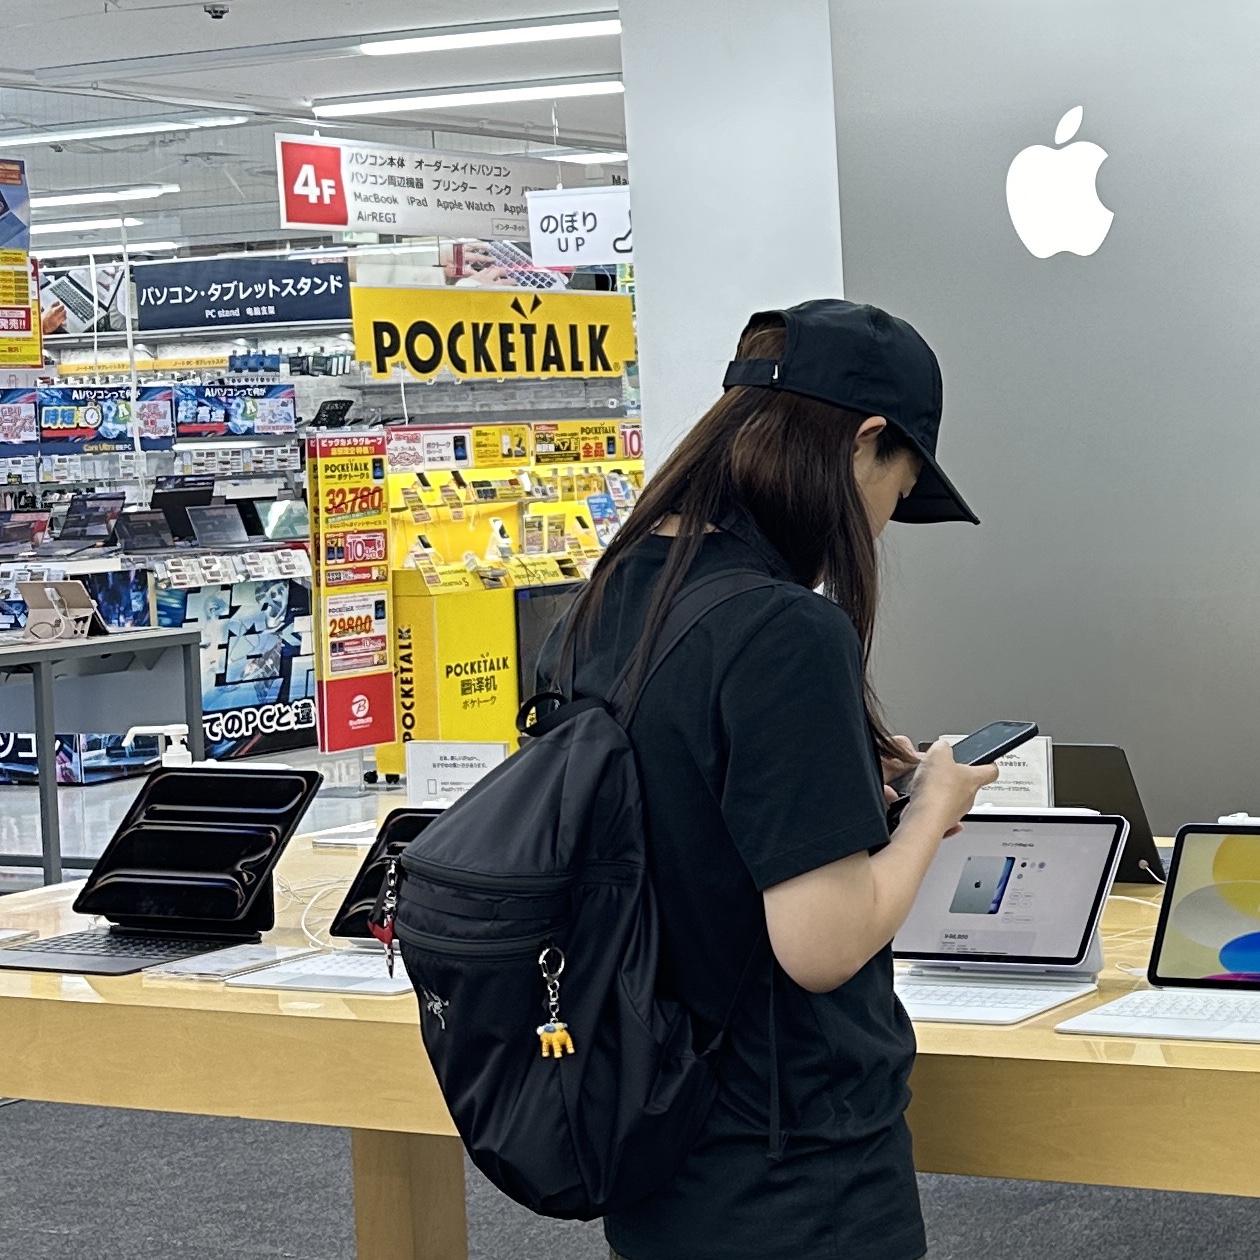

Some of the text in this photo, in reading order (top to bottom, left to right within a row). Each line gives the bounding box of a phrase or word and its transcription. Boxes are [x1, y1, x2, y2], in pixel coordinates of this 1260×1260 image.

[349, 152, 511, 178] パソコン本体 オーダーメイドパソコン
[293, 163, 337, 205] 4F
[432, 178, 478, 194] プリンター
[486, 183, 512, 196] インク
[353, 192, 399, 205] MacBook
[406, 196, 428, 208] iPad
[436, 198, 463, 211] Apple
[464, 200, 496, 213] Watch
[356, 210, 397, 224] AirREGI
[540, 211, 598, 235] のぼり
[140, 274, 344, 306] パソコン・タブレットスタンド
[372, 320, 613, 375] POCKETALK
[445, 656, 510, 679] POCKETALK
[462, 695, 497, 710] ポケトーク
